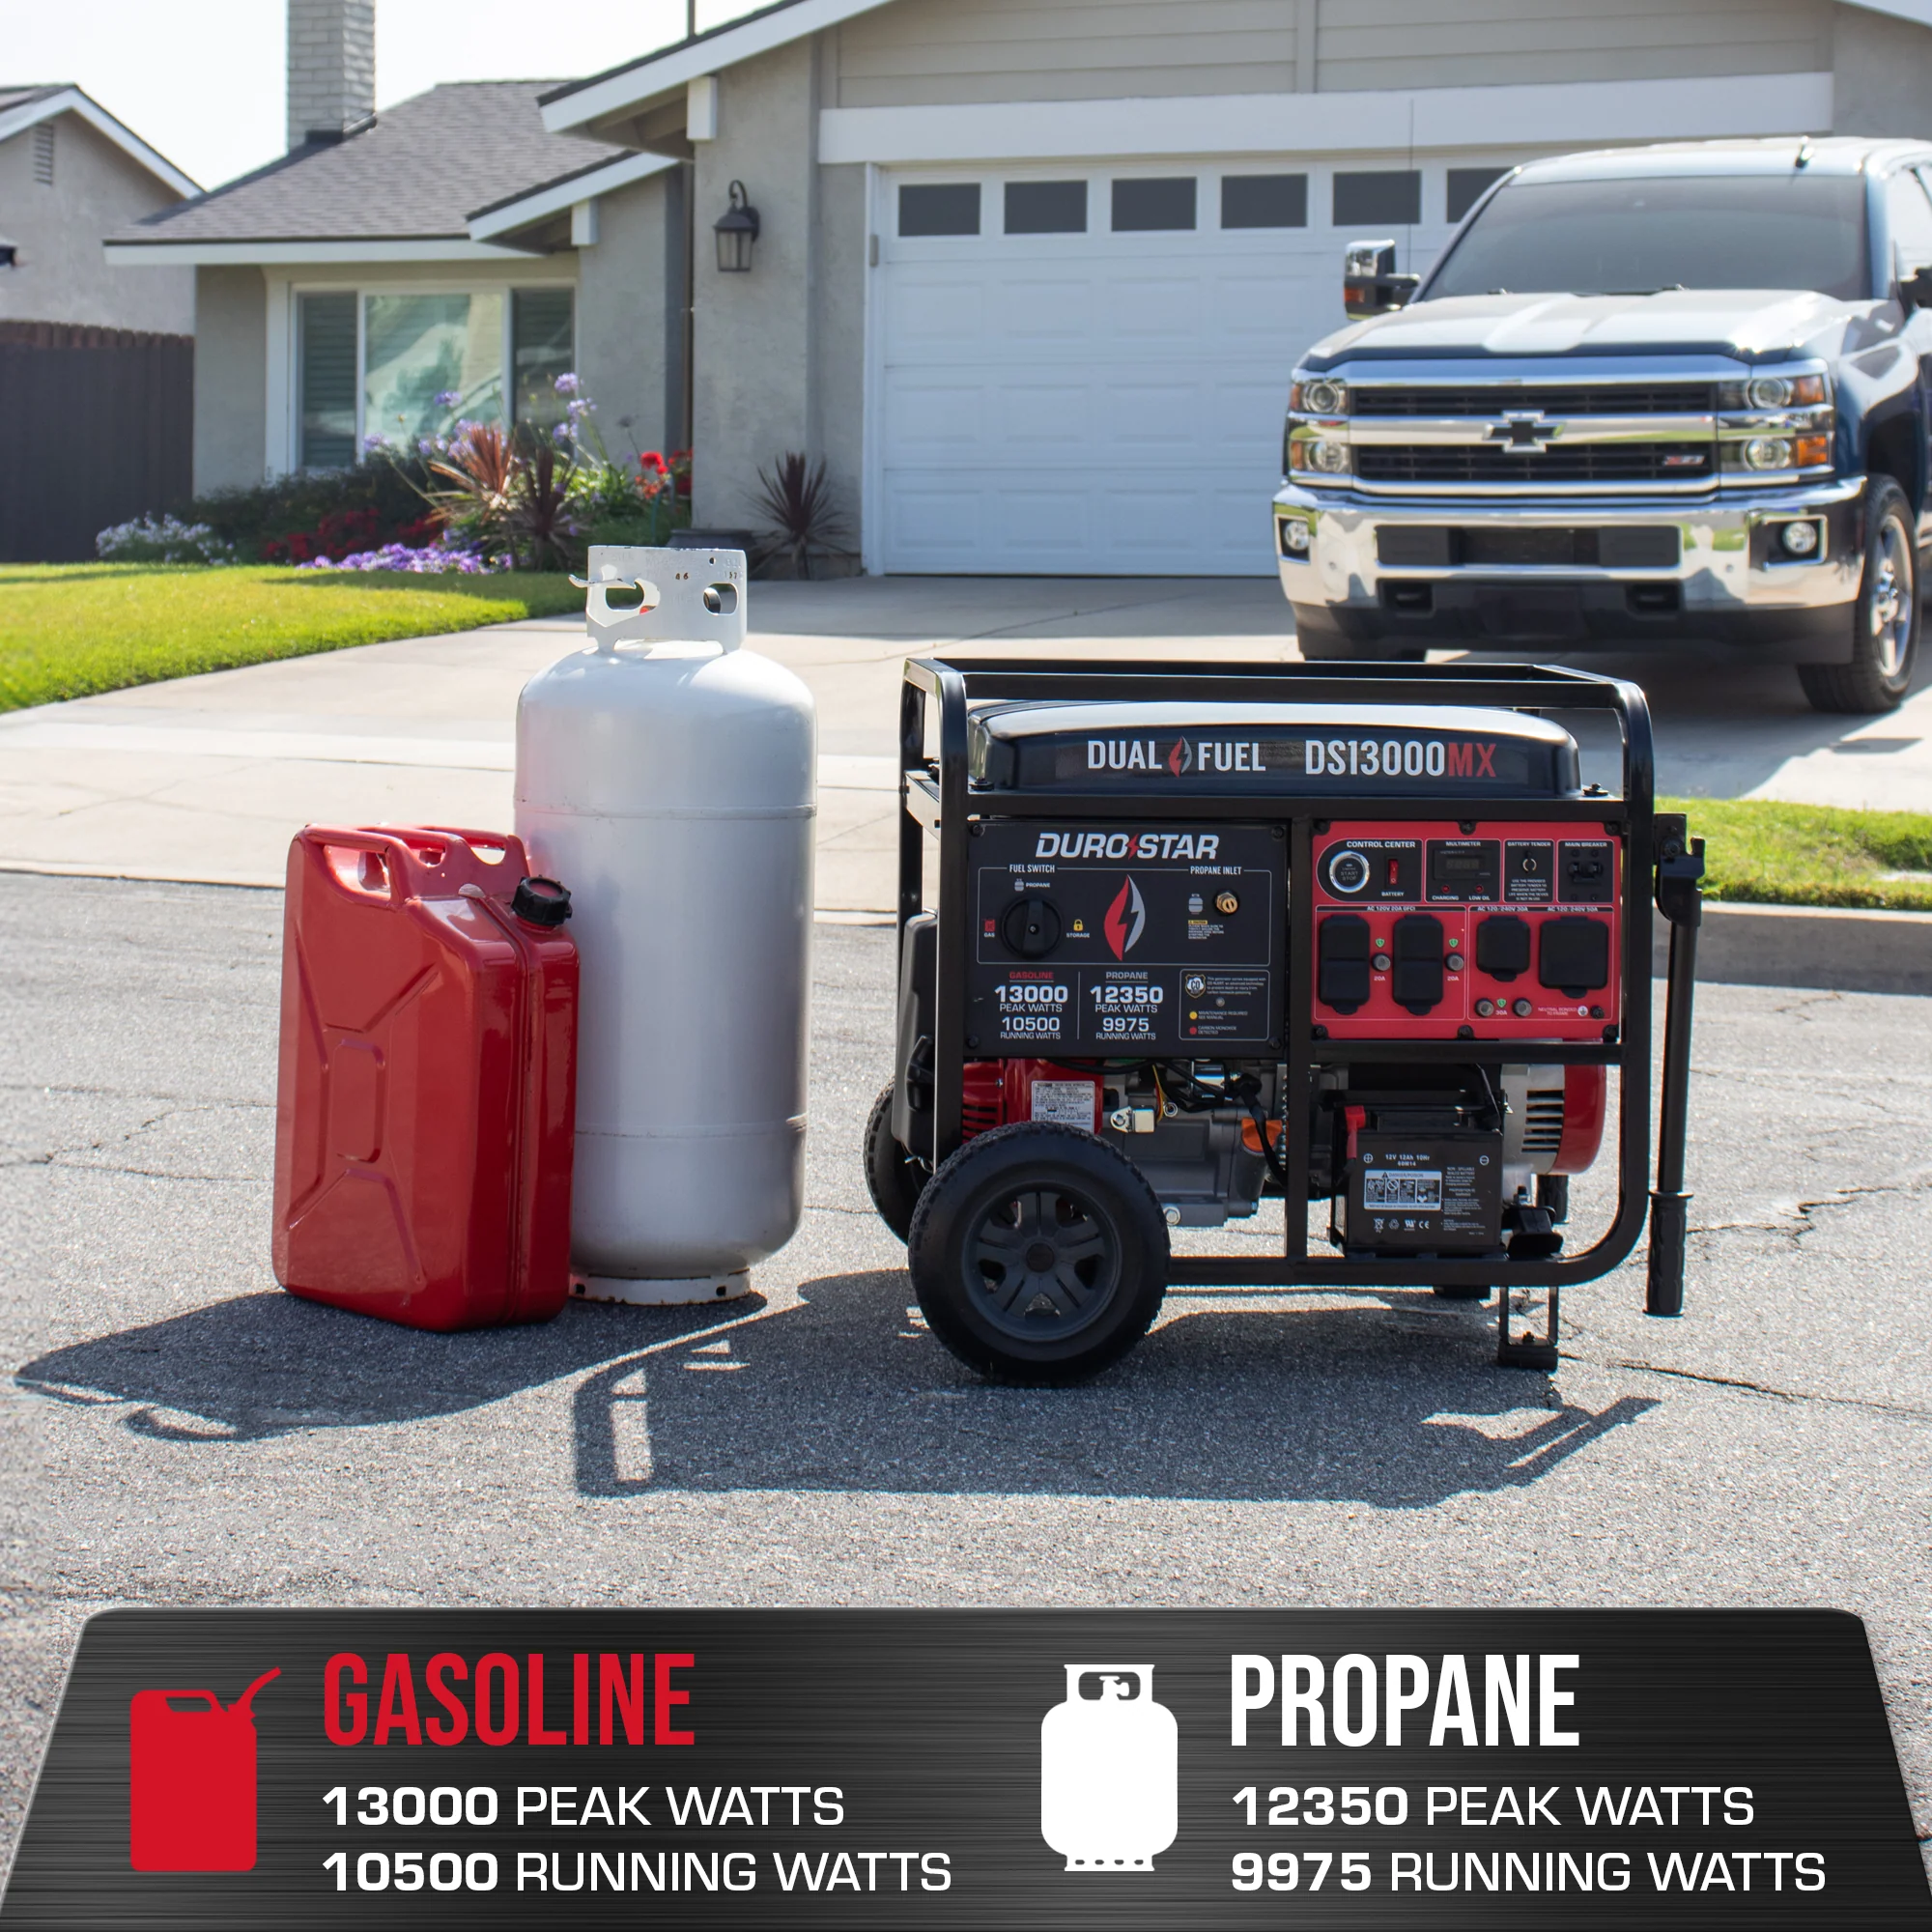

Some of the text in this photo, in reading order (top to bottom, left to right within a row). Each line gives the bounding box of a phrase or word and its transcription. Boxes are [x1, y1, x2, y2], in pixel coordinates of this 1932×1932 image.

[1088, 740, 1496, 778] DUAL FUEL DS13000MX
[1009, 864, 1055, 873] FUEL SWITCH
[1190, 866, 1241, 875] PROPANE INLET
[1191, 980, 1200, 989] CO
[994, 985, 1068, 1003] 13000
[1090, 985, 1164, 1004] 12350
[1000, 1004, 1063, 1012] PEAK WATTS
[1095, 1004, 1157, 1013] PEAK WATTS
[1002, 1016, 1060, 1032] 10500
[1102, 1017, 1150, 1032] 9975
[1095, 1032, 1130, 1040] RUNNING
